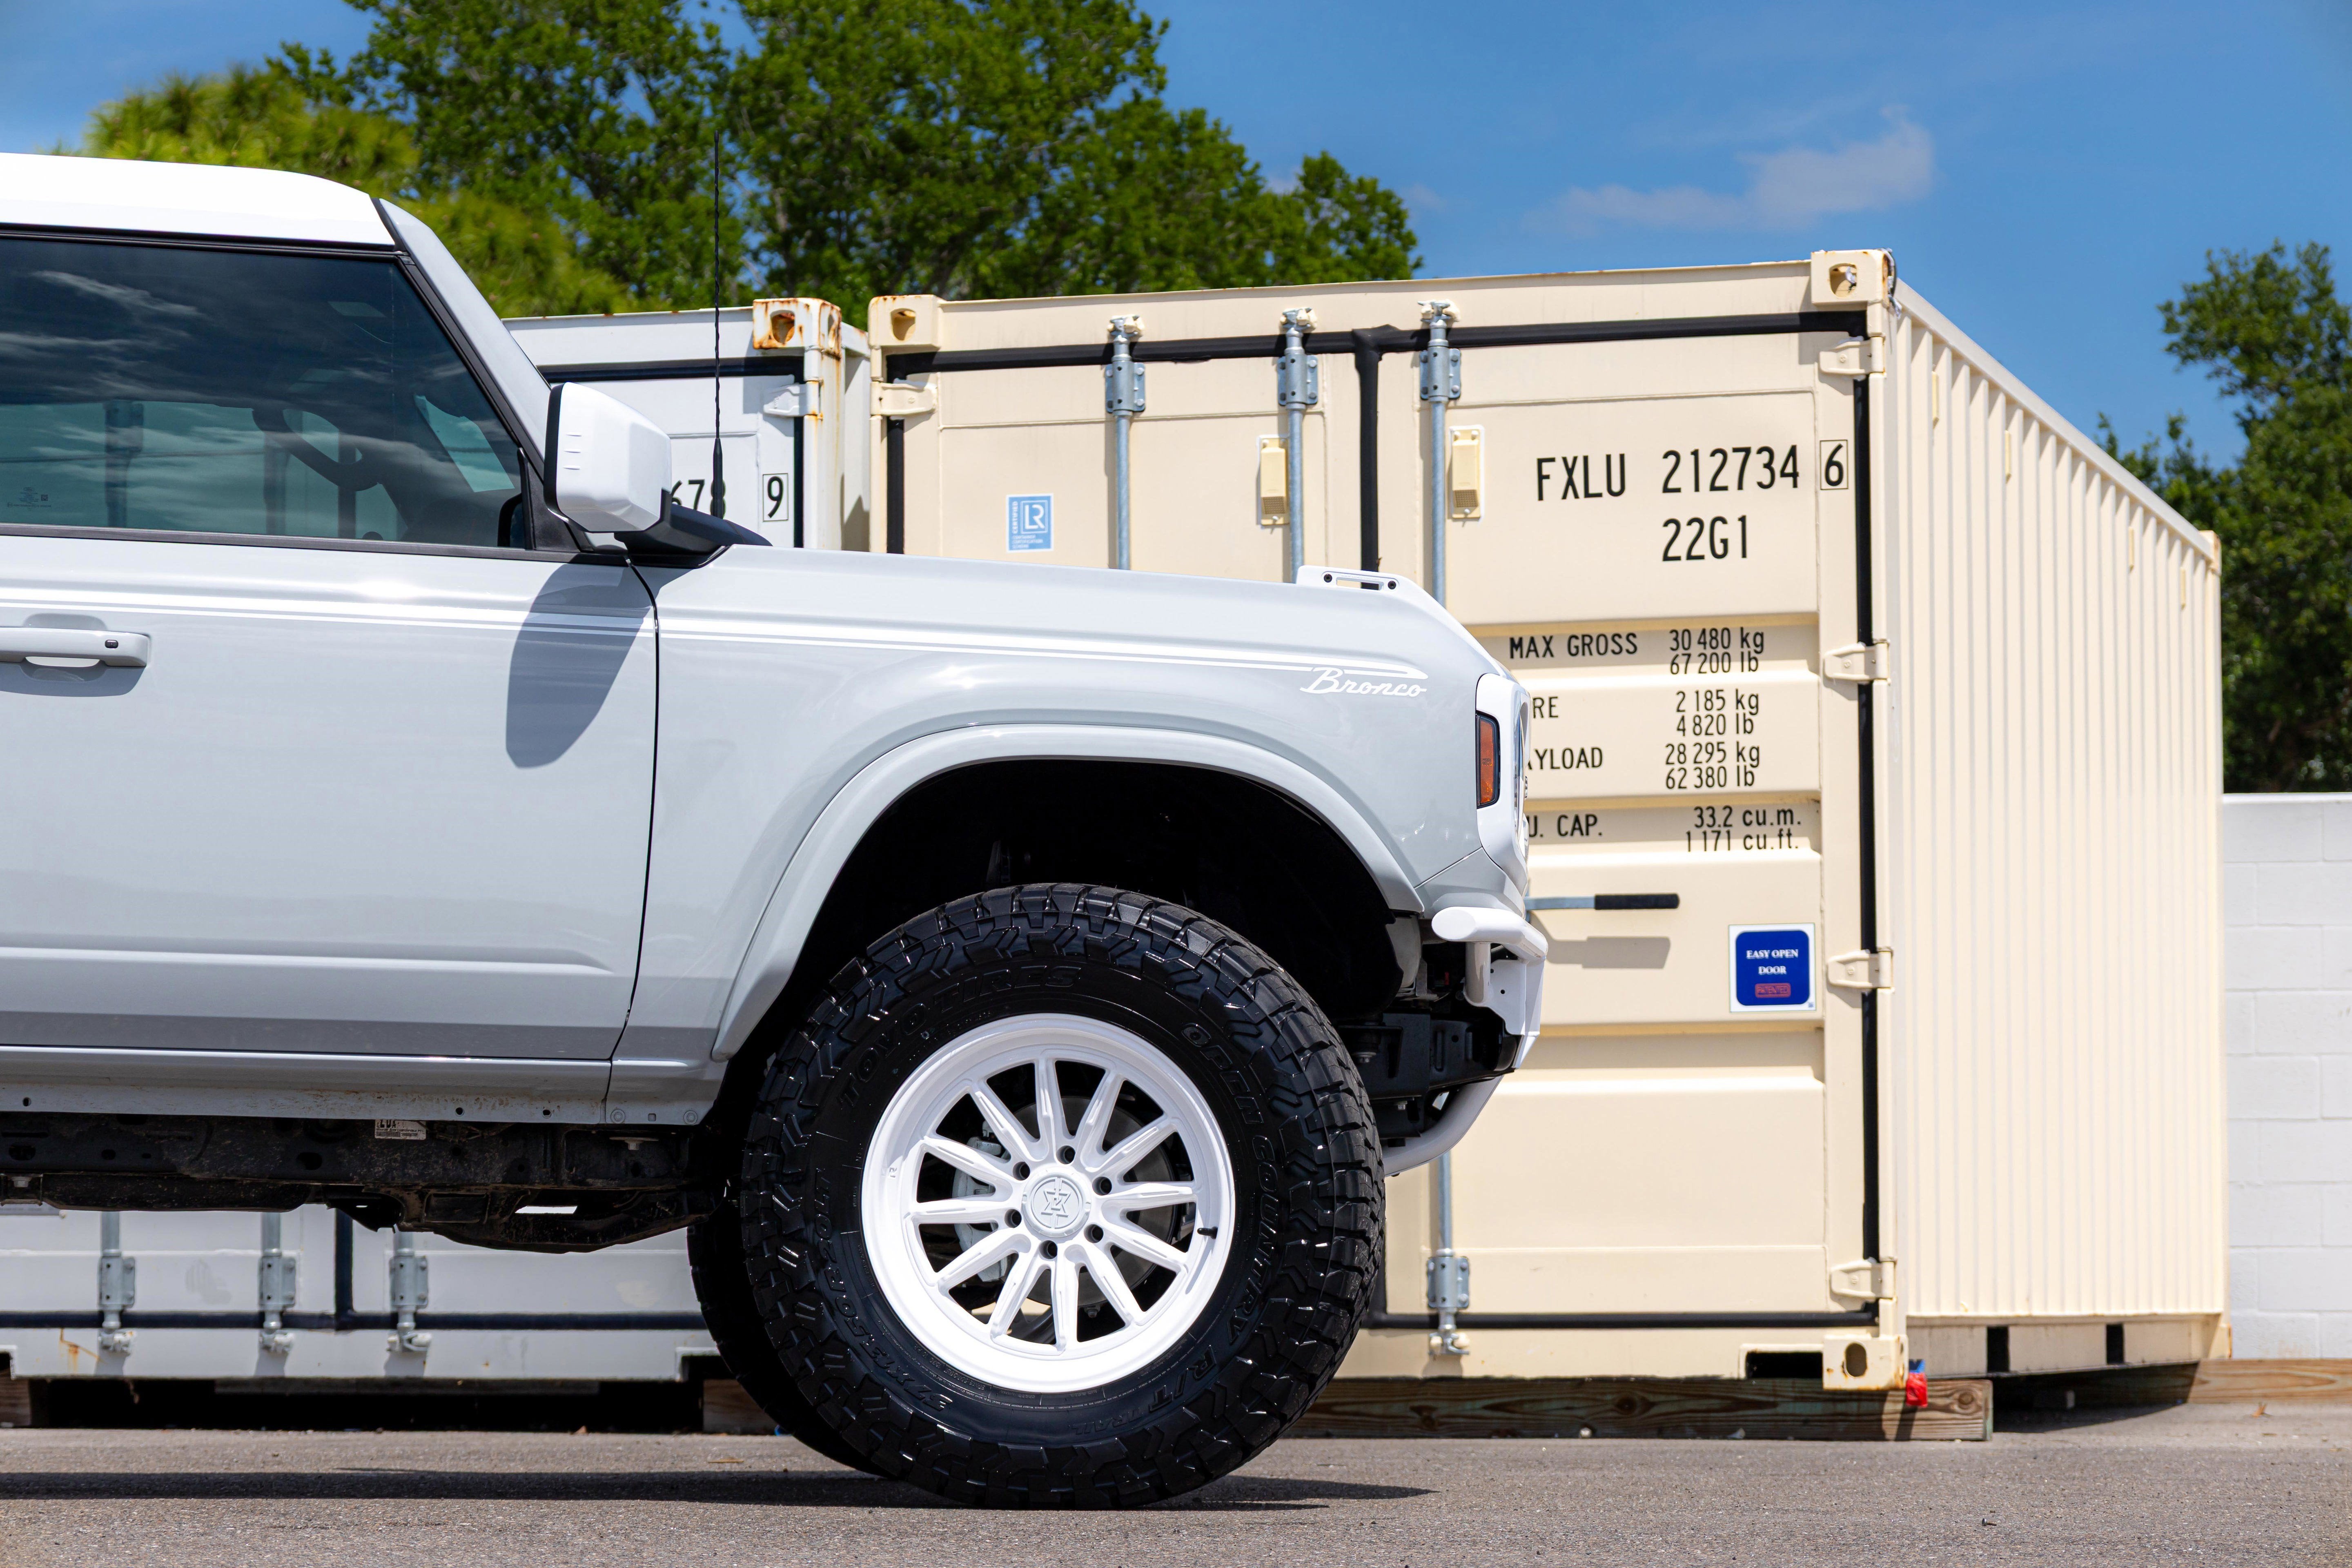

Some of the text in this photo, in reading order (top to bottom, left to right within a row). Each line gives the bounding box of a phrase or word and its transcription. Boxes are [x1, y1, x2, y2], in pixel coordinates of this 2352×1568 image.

[1537, 444, 1844, 501] FXLU 212734 6
[767, 476, 784, 518] 9
[1025, 504, 1045, 529] LR
[1662, 515, 1746, 561] 22G1
[1510, 635, 1554, 659] MAX
[1567, 633, 1637, 657] GROSS
[1740, 627, 1764, 654] kg
[1741, 652, 1759, 673] lb
[1300, 666, 1427, 697] Bronco
[1532, 696, 1559, 719] RE
[1736, 689, 1759, 715] kg
[1736, 715, 1754, 735] lb
[1528, 747, 1603, 770] YLOAD
[1737, 741, 1760, 768] kg
[1737, 766, 1755, 787] lb
[1526, 815, 1544, 837] U.
[1557, 814, 1602, 837] CAP.
[1694, 805, 1733, 829] 33.2
[1746, 949, 1798, 959] EASY OPEN
[1758, 966, 1787, 975] DOOR
[838, 1003, 928, 1107] TOYO
[934, 966, 1082, 1013] TIRES
[1181, 1022, 1264, 1124] OPEN
[1227, 1135, 1279, 1344] COUNTRY
[1148, 1345, 1217, 1413] R/T
